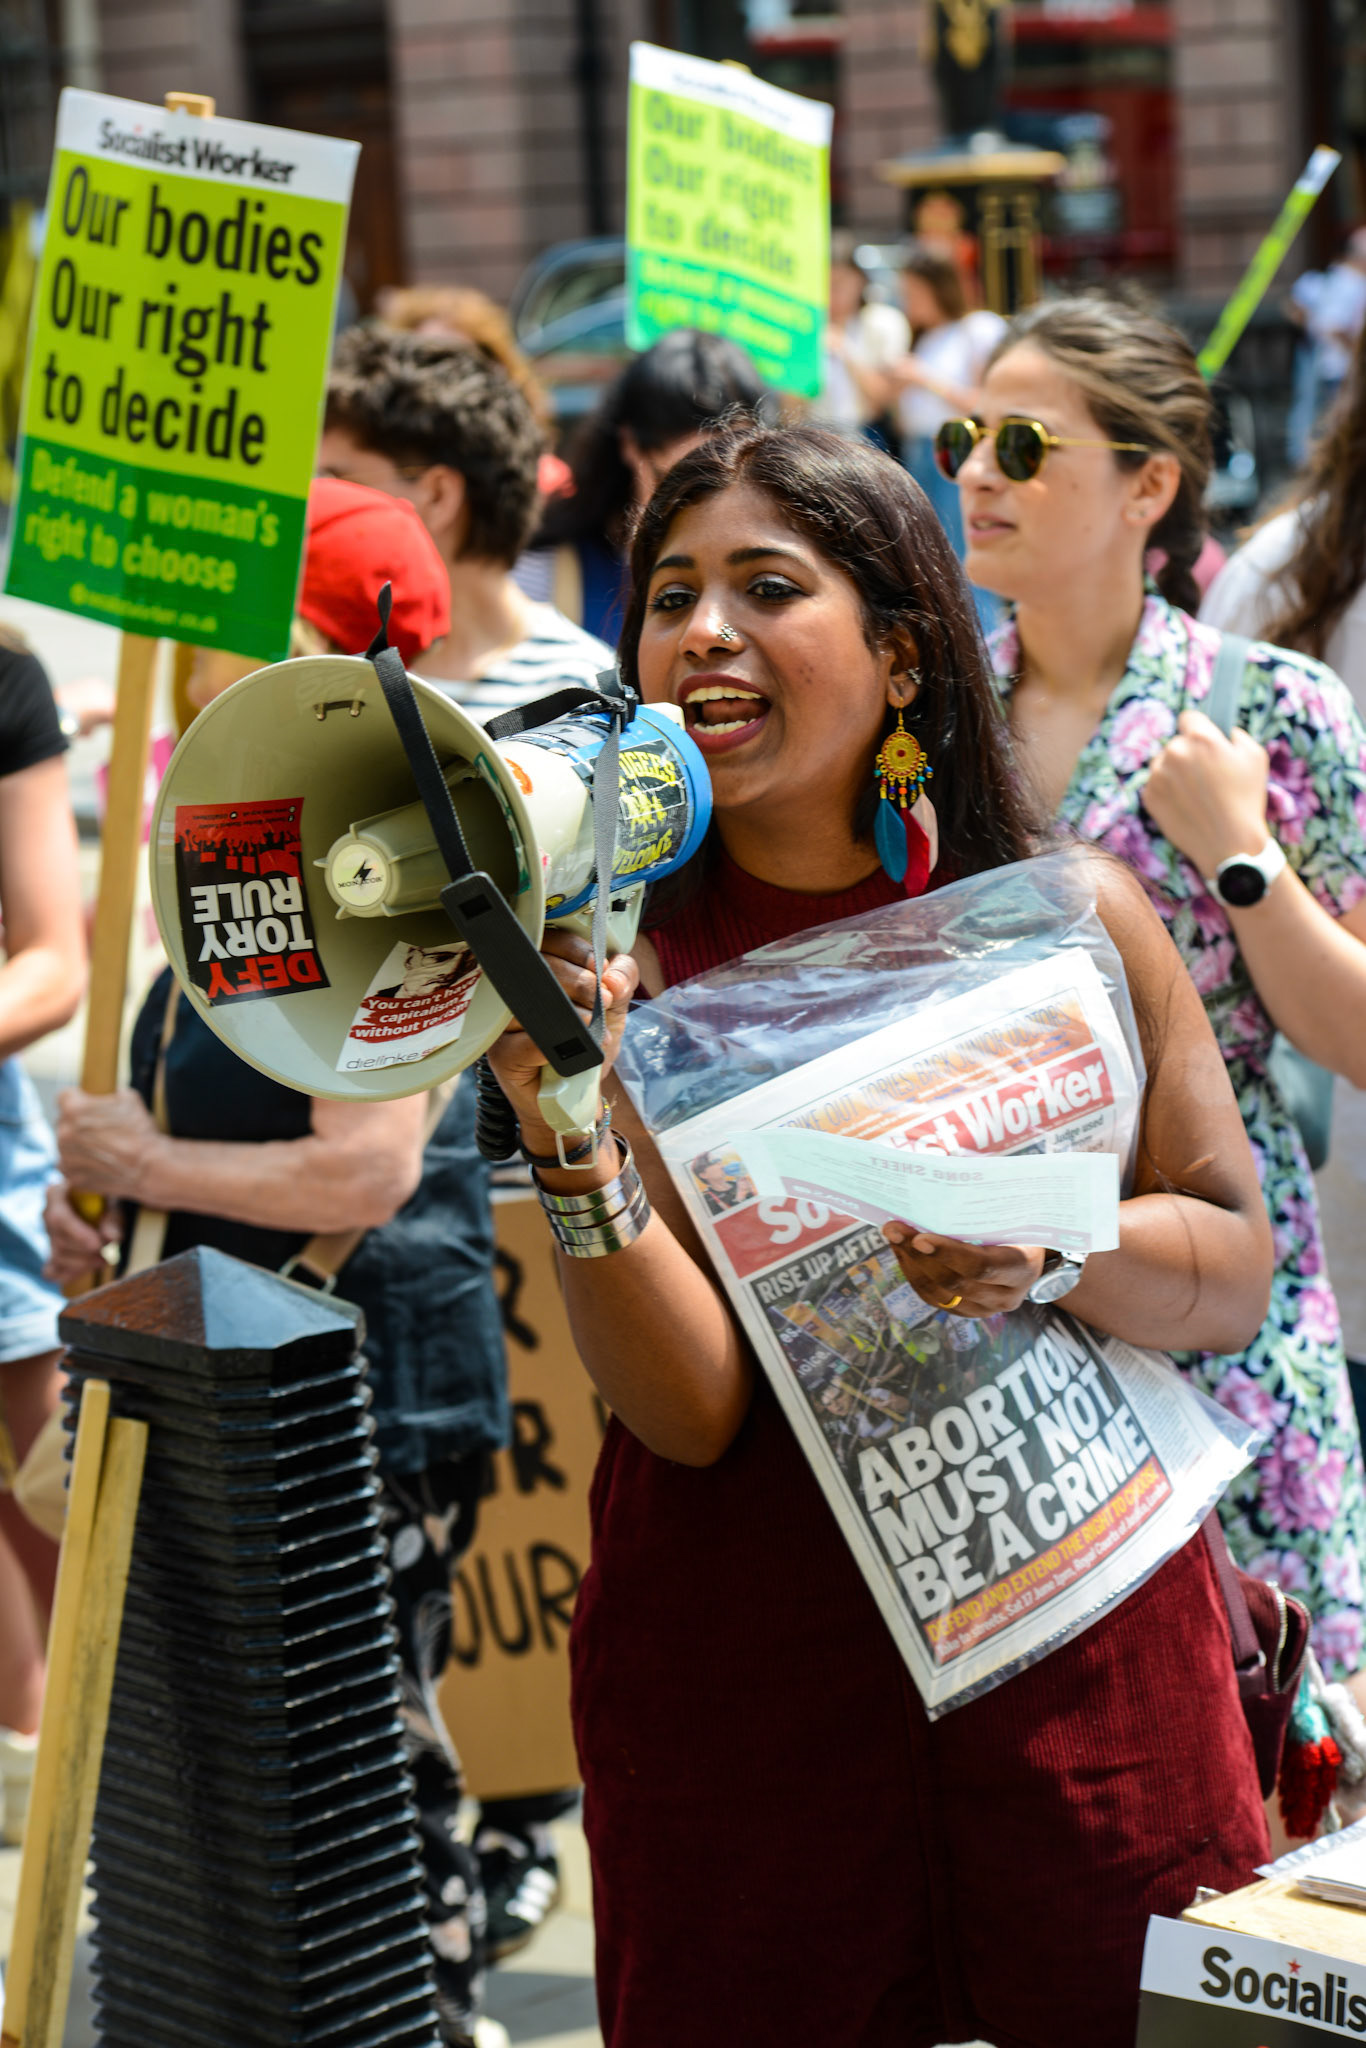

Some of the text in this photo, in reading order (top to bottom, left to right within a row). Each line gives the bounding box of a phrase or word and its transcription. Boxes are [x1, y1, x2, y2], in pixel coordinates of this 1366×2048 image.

[99, 119, 296, 186] Socialist Worker
[63, 165, 324, 287] Our bodies
[50, 257, 272, 377] Our right
[41, 353, 266, 466] to decide
[32, 447, 280, 548] Defend a woman's
[25, 510, 236, 594] right to choose
[190, 875, 304, 924] RULE
[198, 914, 314, 962] TORY
[207, 951, 322, 999] DEFY
[368, 1000, 399, 1010] You
[403, 994, 441, 1009] can't
[380, 997, 459, 1023] capitalism
[355, 1021, 420, 1038] without
[824, 1094, 861, 1126] OUT
[964, 1057, 1108, 1150] Worker
[756, 1229, 890, 1304] RISE UP AFTE
[855, 1313, 1092, 1511] ABORTION
[869, 1430, 1029, 1567] MUST
[1034, 1361, 1112, 1470] NOT
[896, 1536, 985, 1620] BE
[985, 1510, 1037, 1576] A
[1026, 1406, 1152, 1542] CRIME
[928, 1600, 983, 1643] DEFEND
[981, 1580, 1011, 1608] AND
[1009, 1552, 1062, 1594] EXTEND
[1059, 1533, 1087, 1561] THE
[1083, 1506, 1116, 1544] RIGHT
[1110, 1495, 1129, 1518] TO
[1005, 1601, 1022, 1618] Sat
